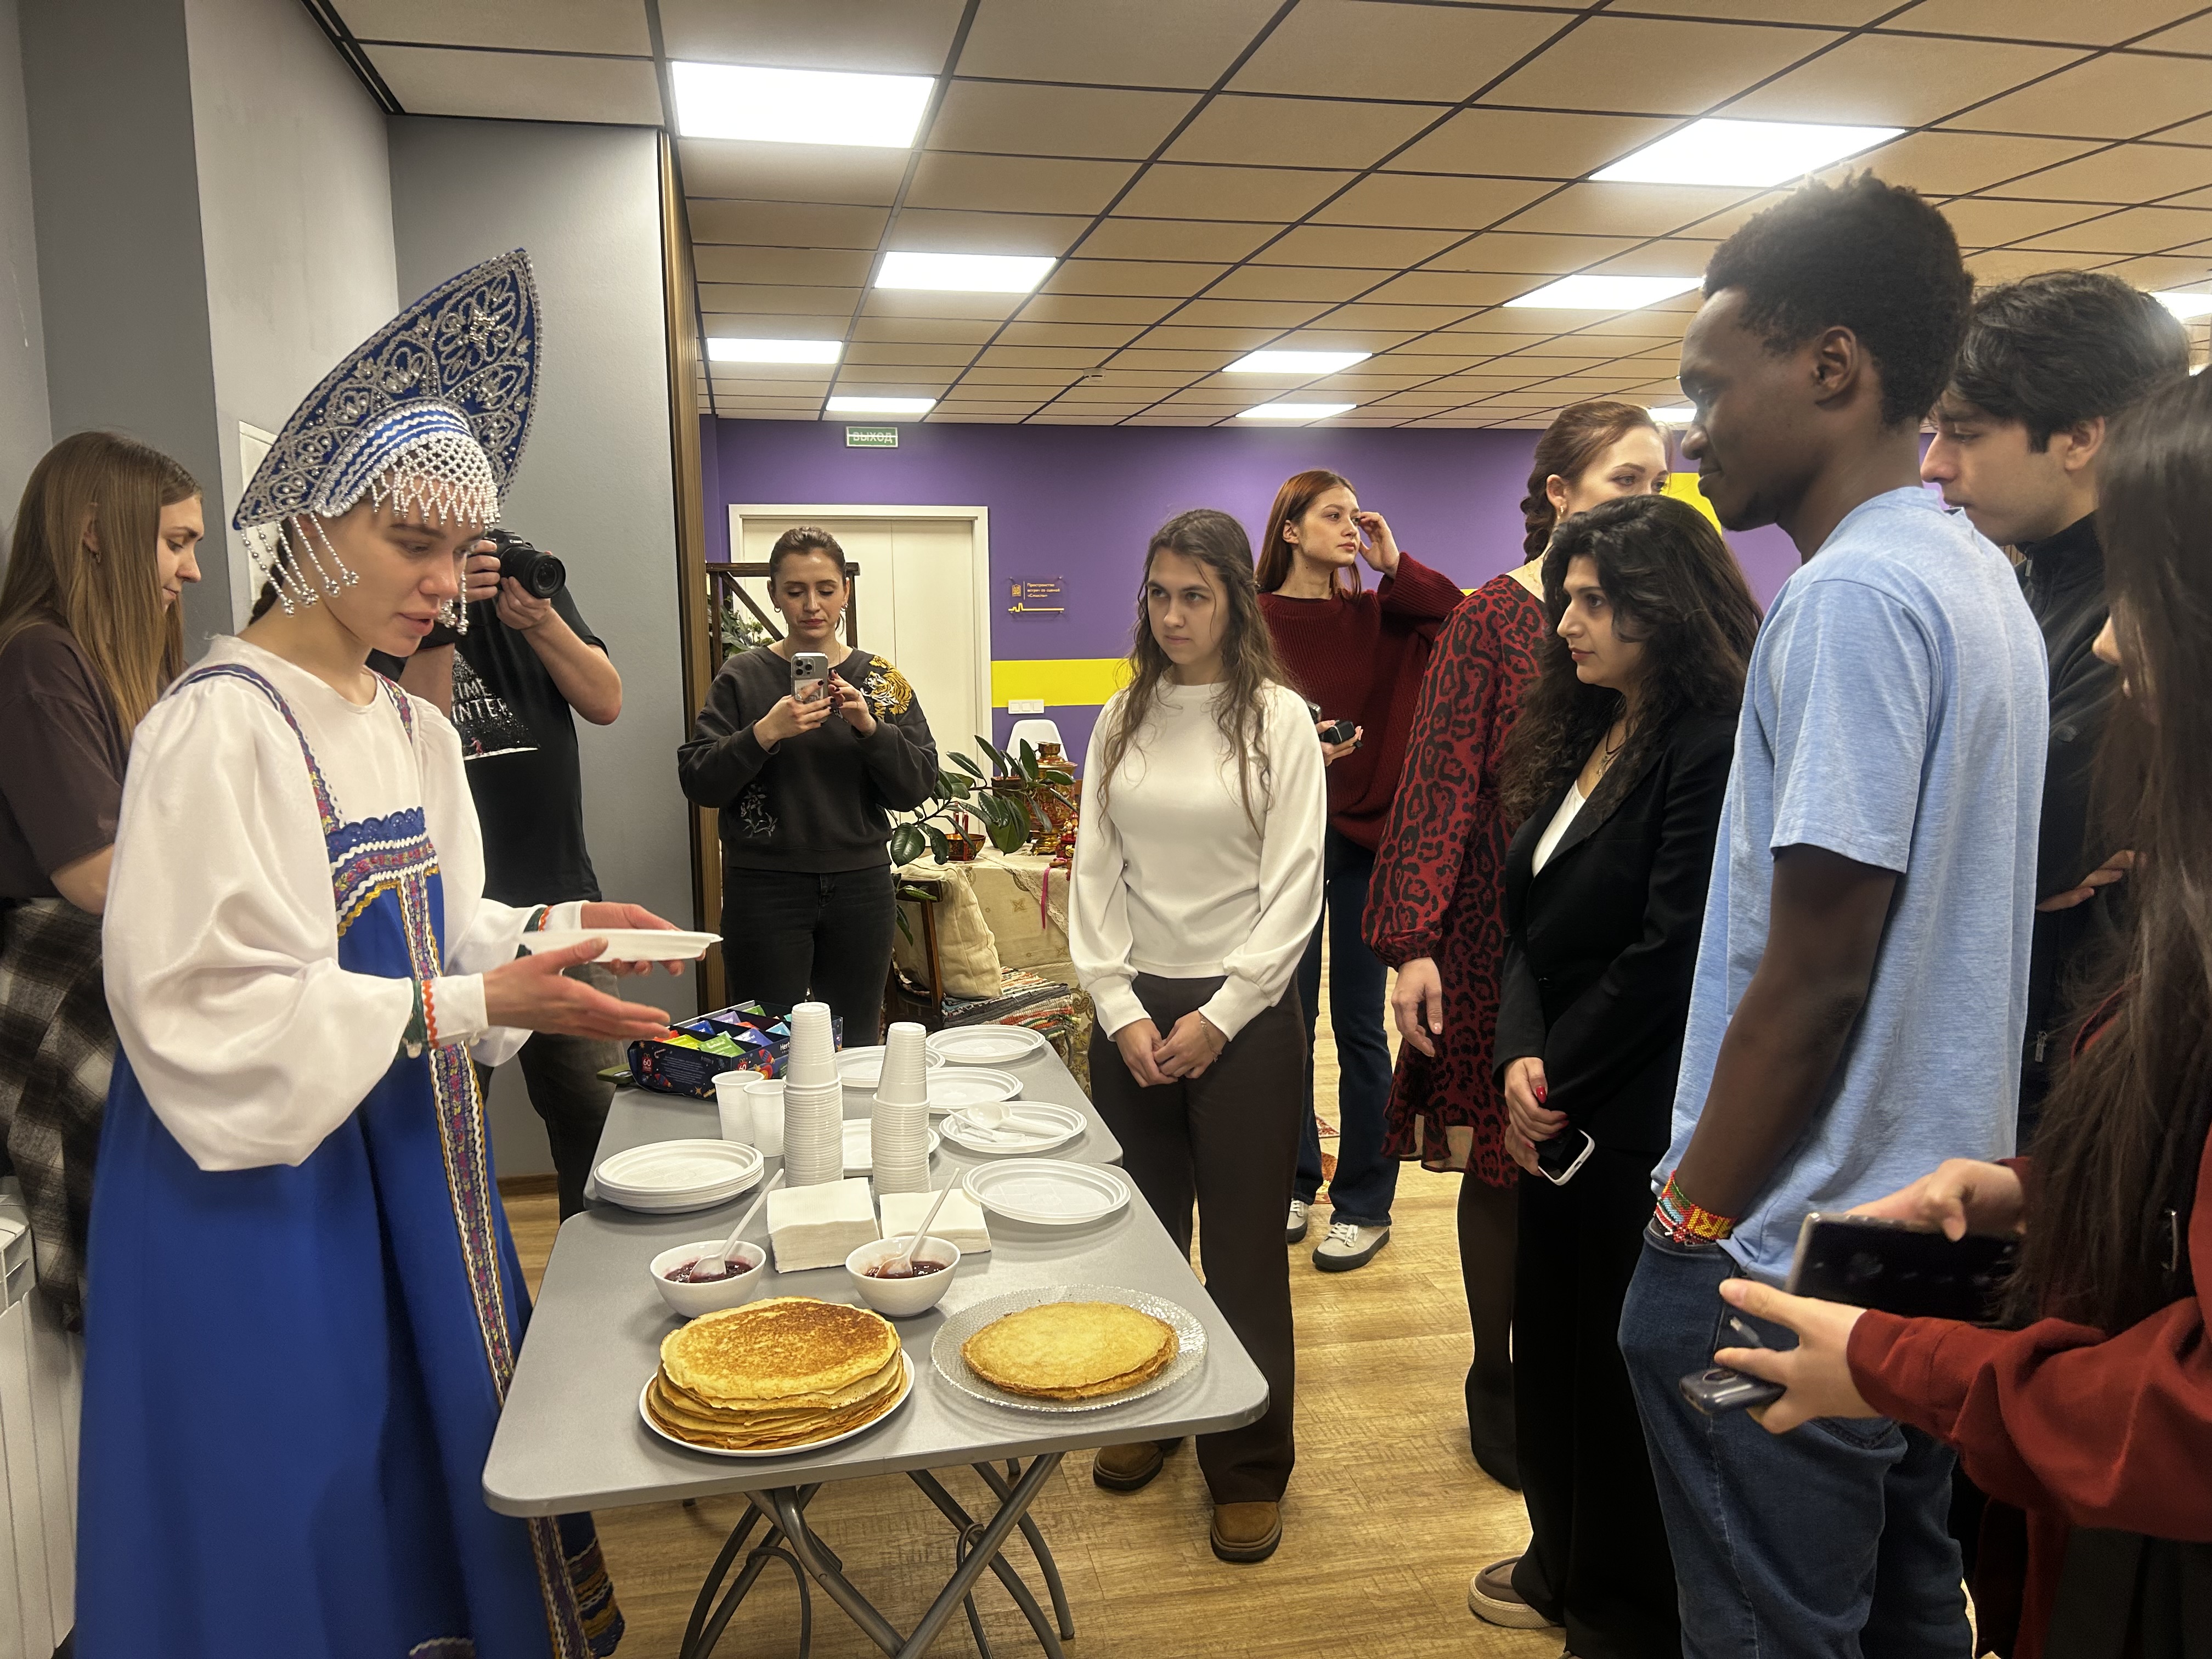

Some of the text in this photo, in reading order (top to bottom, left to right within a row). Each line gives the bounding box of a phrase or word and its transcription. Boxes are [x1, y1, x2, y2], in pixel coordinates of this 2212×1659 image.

[853, 431, 893, 443] ВЫХОД
[452, 698, 507, 724] INTER
[643, 1059, 651, 1067] 60
